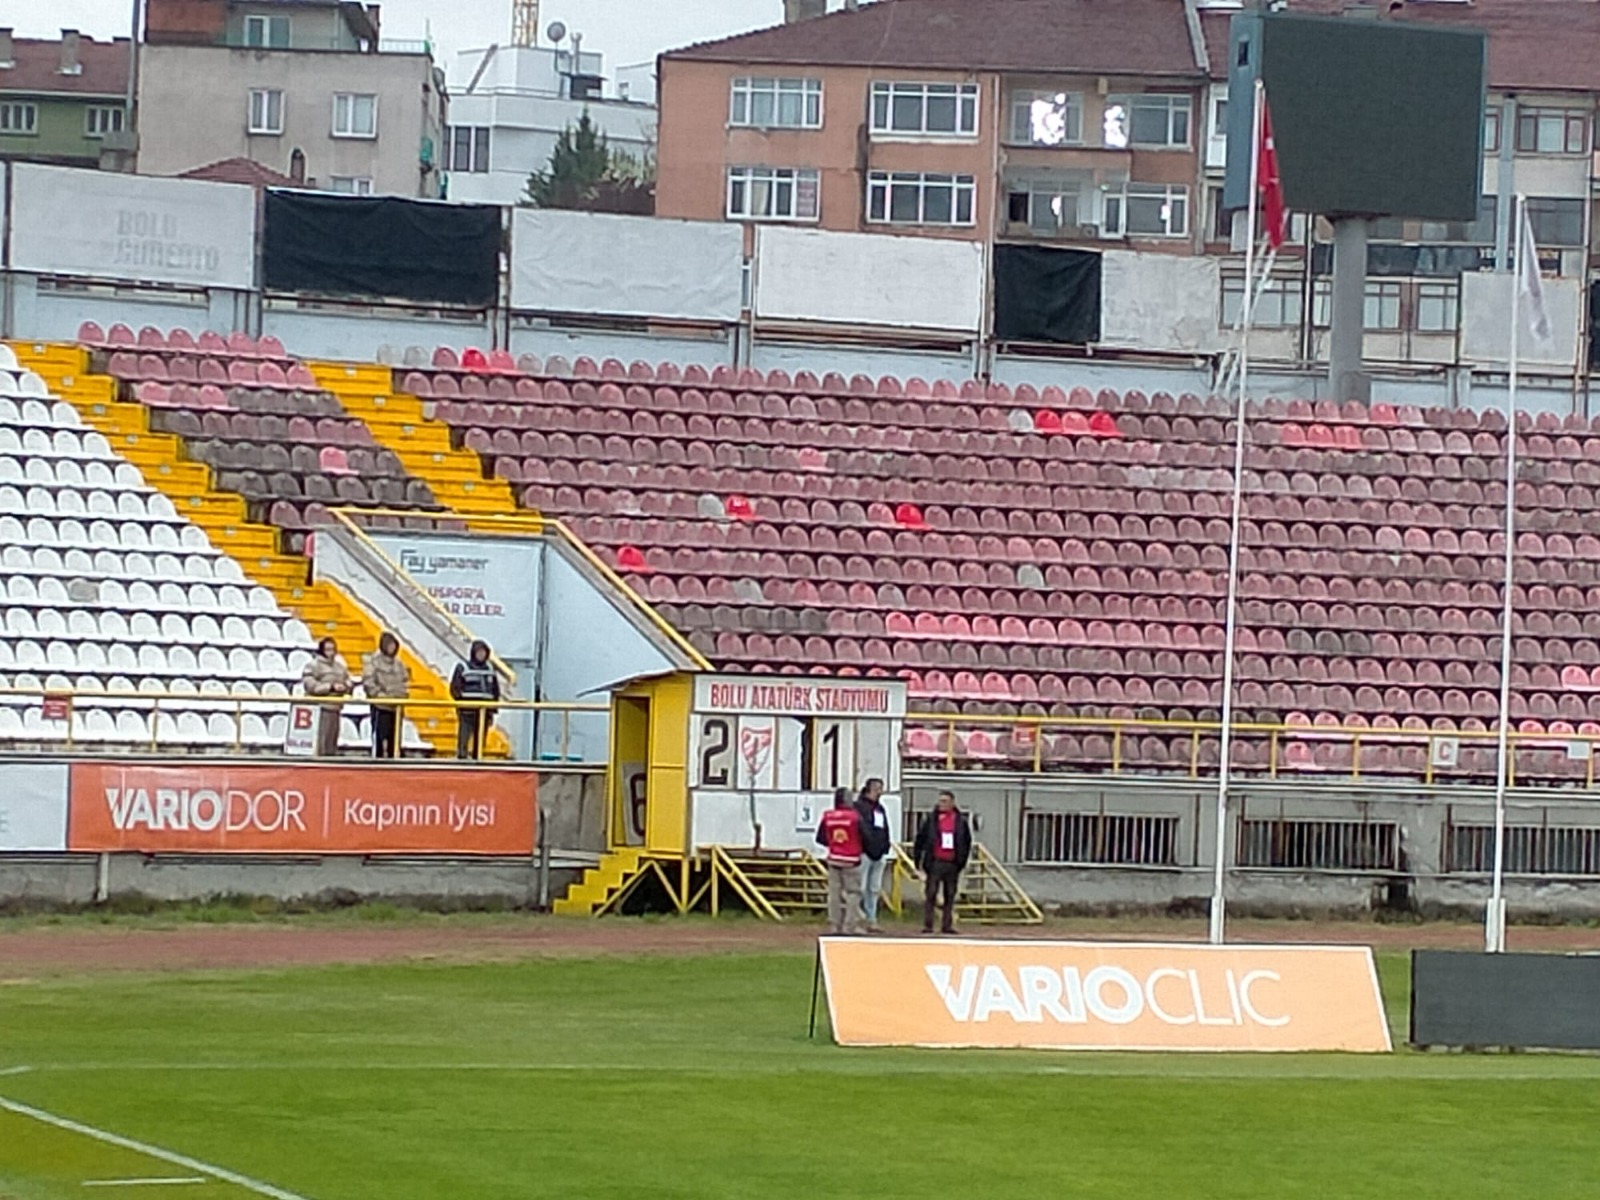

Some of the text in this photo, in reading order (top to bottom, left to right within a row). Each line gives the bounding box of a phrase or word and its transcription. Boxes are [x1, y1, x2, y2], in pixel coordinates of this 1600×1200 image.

[117, 209, 177, 238] BOLU
[428, 586, 486, 601] USPOR'A
[711, 683, 747, 709] BOLU
[751, 681, 812, 711] ATATÜRK
[294, 706, 313, 730] B
[702, 719, 729, 786] 2
[823, 724, 839, 788] 1
[1438, 741, 1452, 762] C
[106, 787, 306, 832] VARIODOR
[344, 798, 441, 831] Kapının
[801, 807, 811, 822] 3
[924, 965, 1291, 1028] VARIOCLIC
